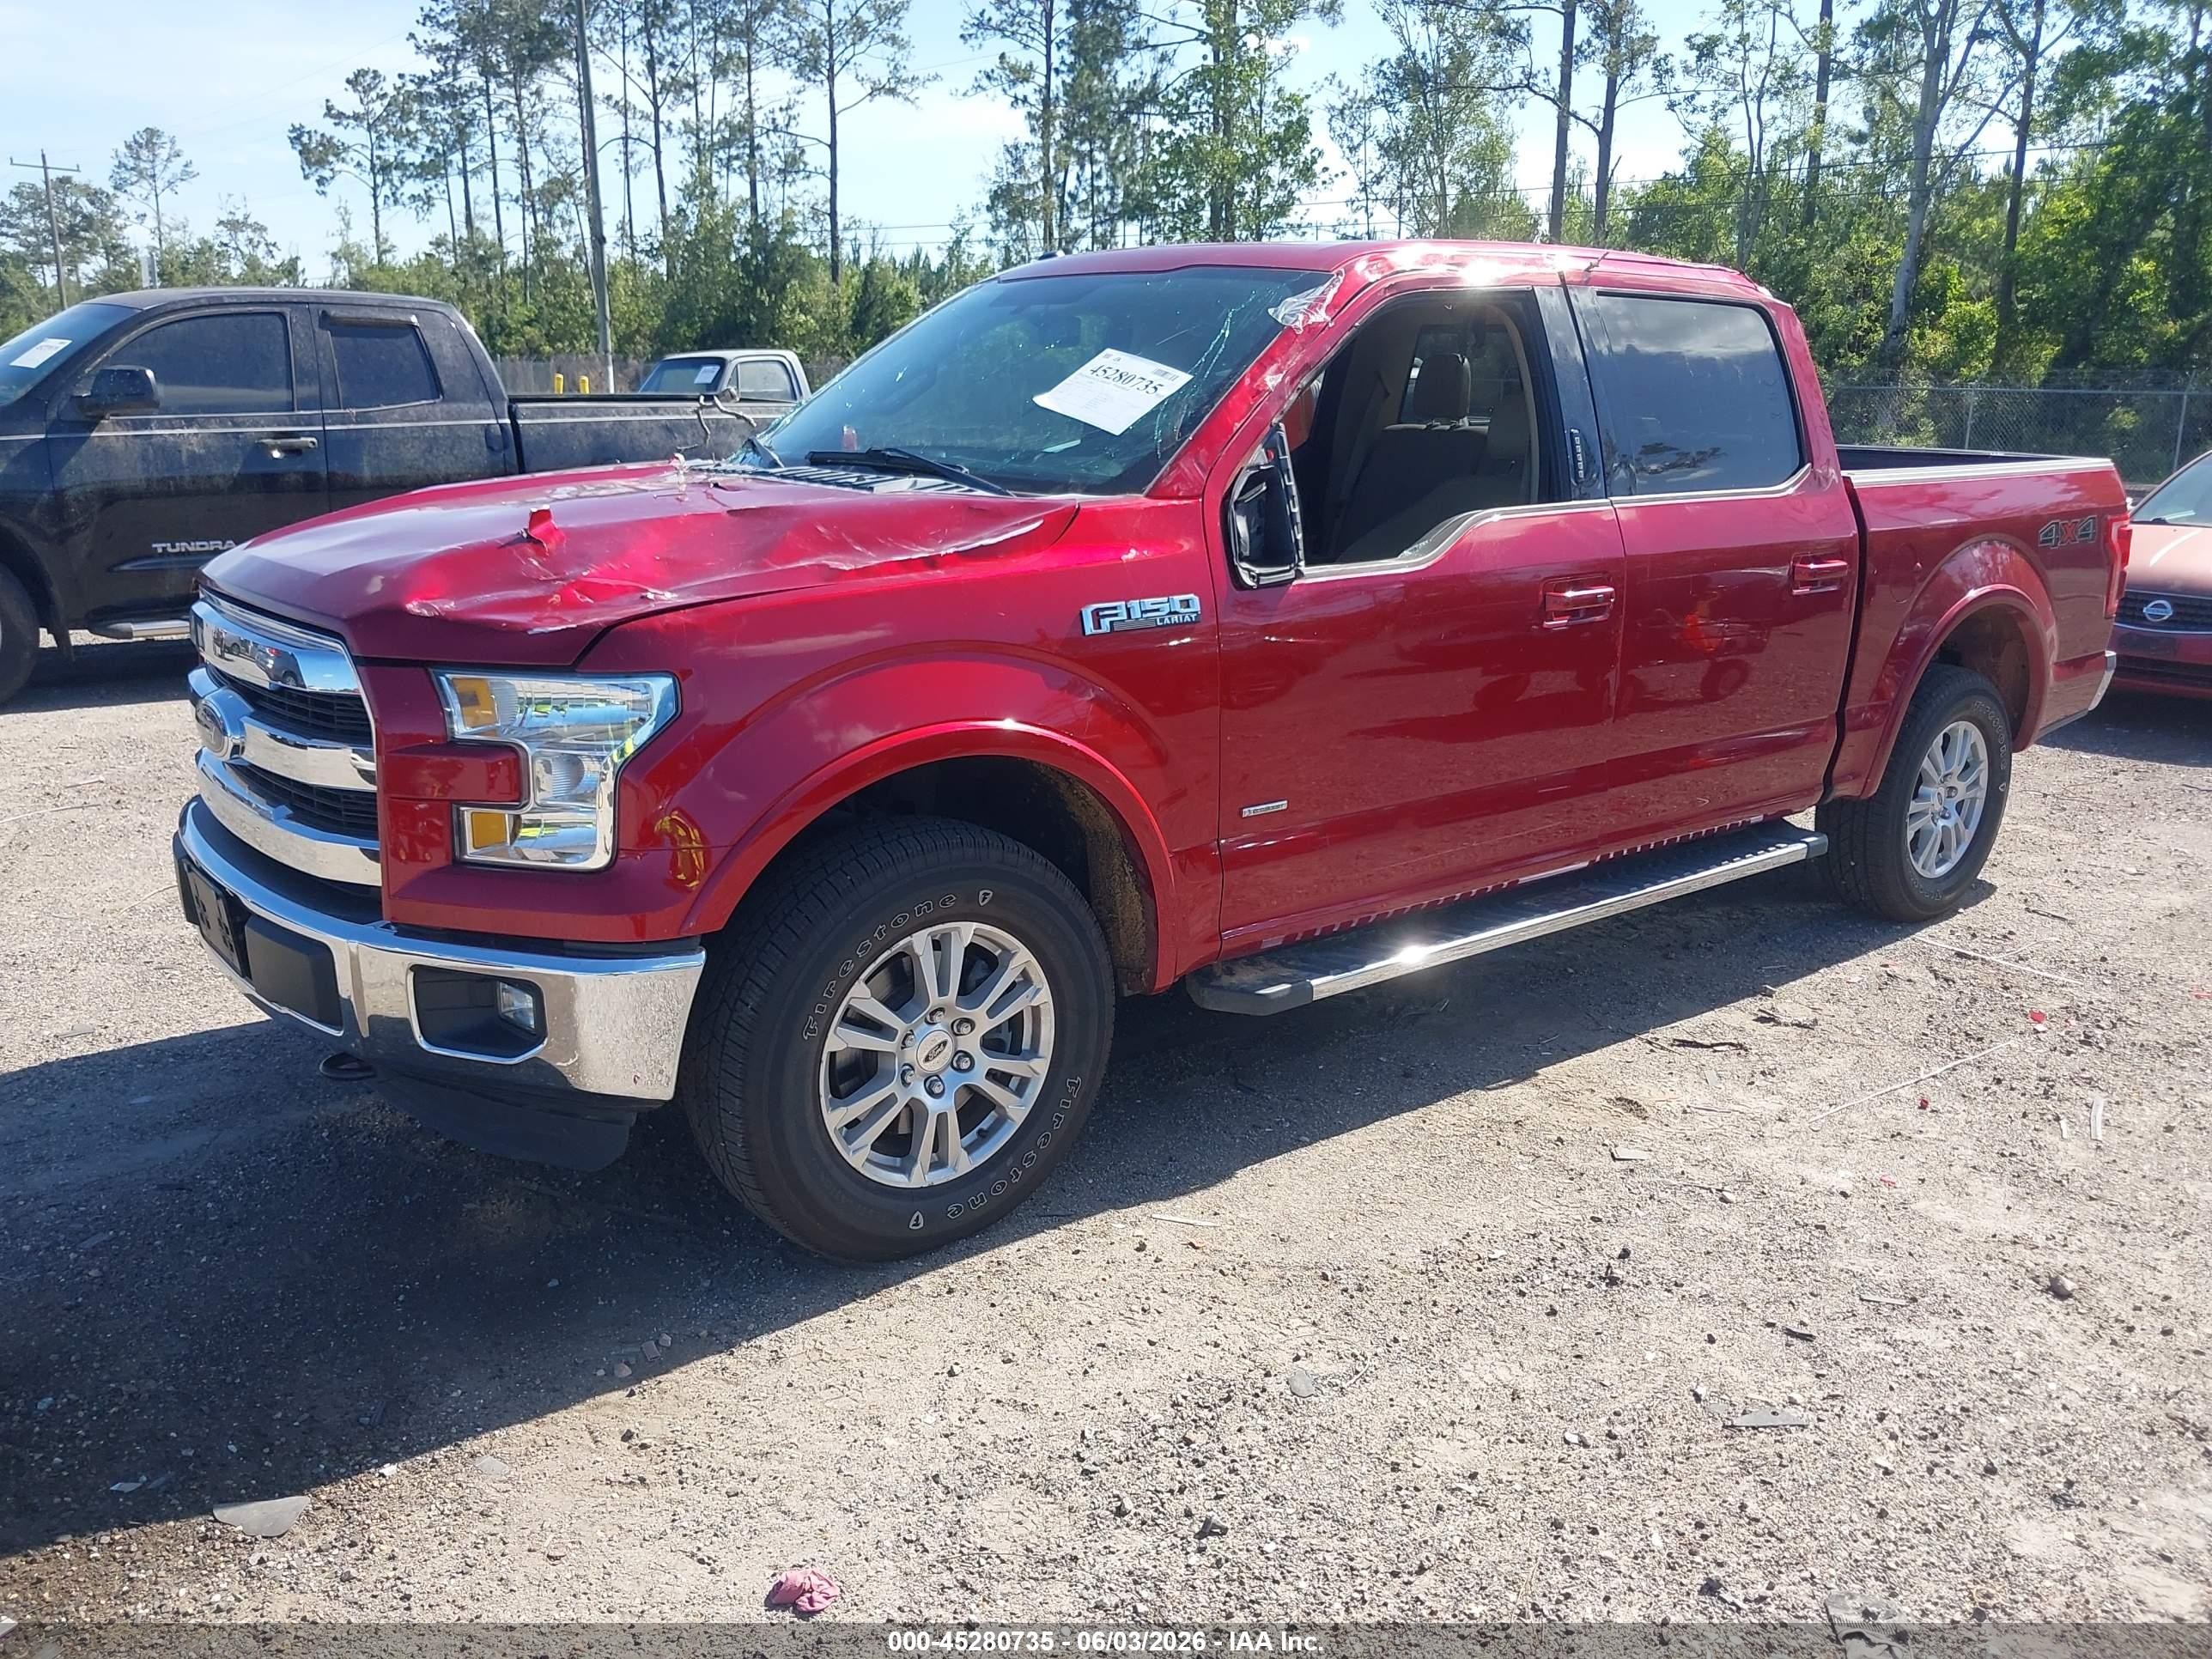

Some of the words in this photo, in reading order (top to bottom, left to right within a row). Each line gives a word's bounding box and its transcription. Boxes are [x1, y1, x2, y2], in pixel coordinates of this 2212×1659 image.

[1090, 363, 1165, 396] 45280735
[151, 539, 237, 554] TUNDRA
[1155, 613, 1199, 626] LARIAT
[802, 892, 957, 1041] Firestone
[945, 1075, 1083, 1220] Firestone
